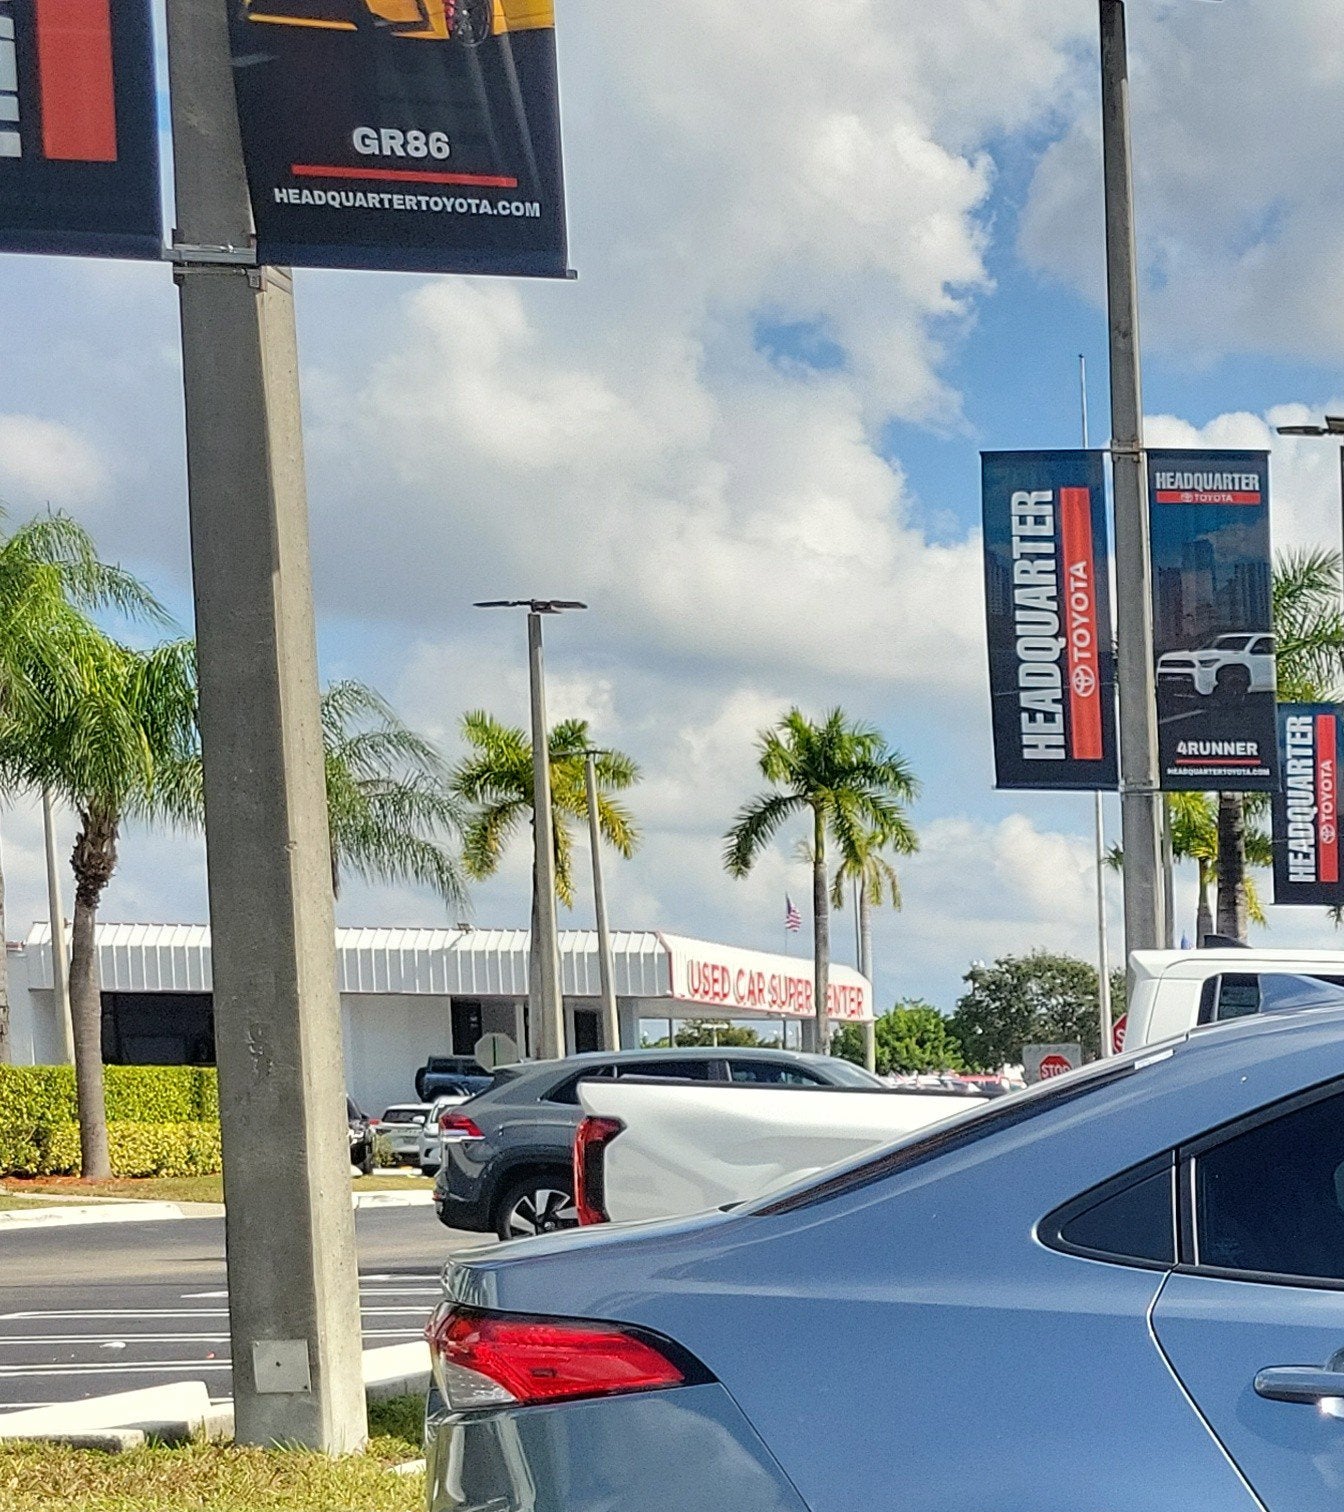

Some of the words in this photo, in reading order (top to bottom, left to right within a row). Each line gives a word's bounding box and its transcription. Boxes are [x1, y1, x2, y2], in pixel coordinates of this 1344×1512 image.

[352, 126, 451, 160] GR86
[273, 187, 541, 218] HEADQUARTERTOYOTA.COM
[1155, 472, 1260, 492] HEADQUARTER
[1194, 493, 1234, 503] TOYOTA
[1011, 489, 1066, 760] HEADQUARTER
[1071, 560, 1089, 662] TOYOTA
[1177, 740, 1258, 756] 4RUNNER
[1286, 715, 1317, 883] HEADQUARTER
[1319, 759, 1334, 825] TOYOTA
[688, 960, 731, 1001] USED
[734, 968, 766, 1006] CAR
[769, 974, 813, 1012] SUPER
[827, 984, 864, 1017] ENTER
